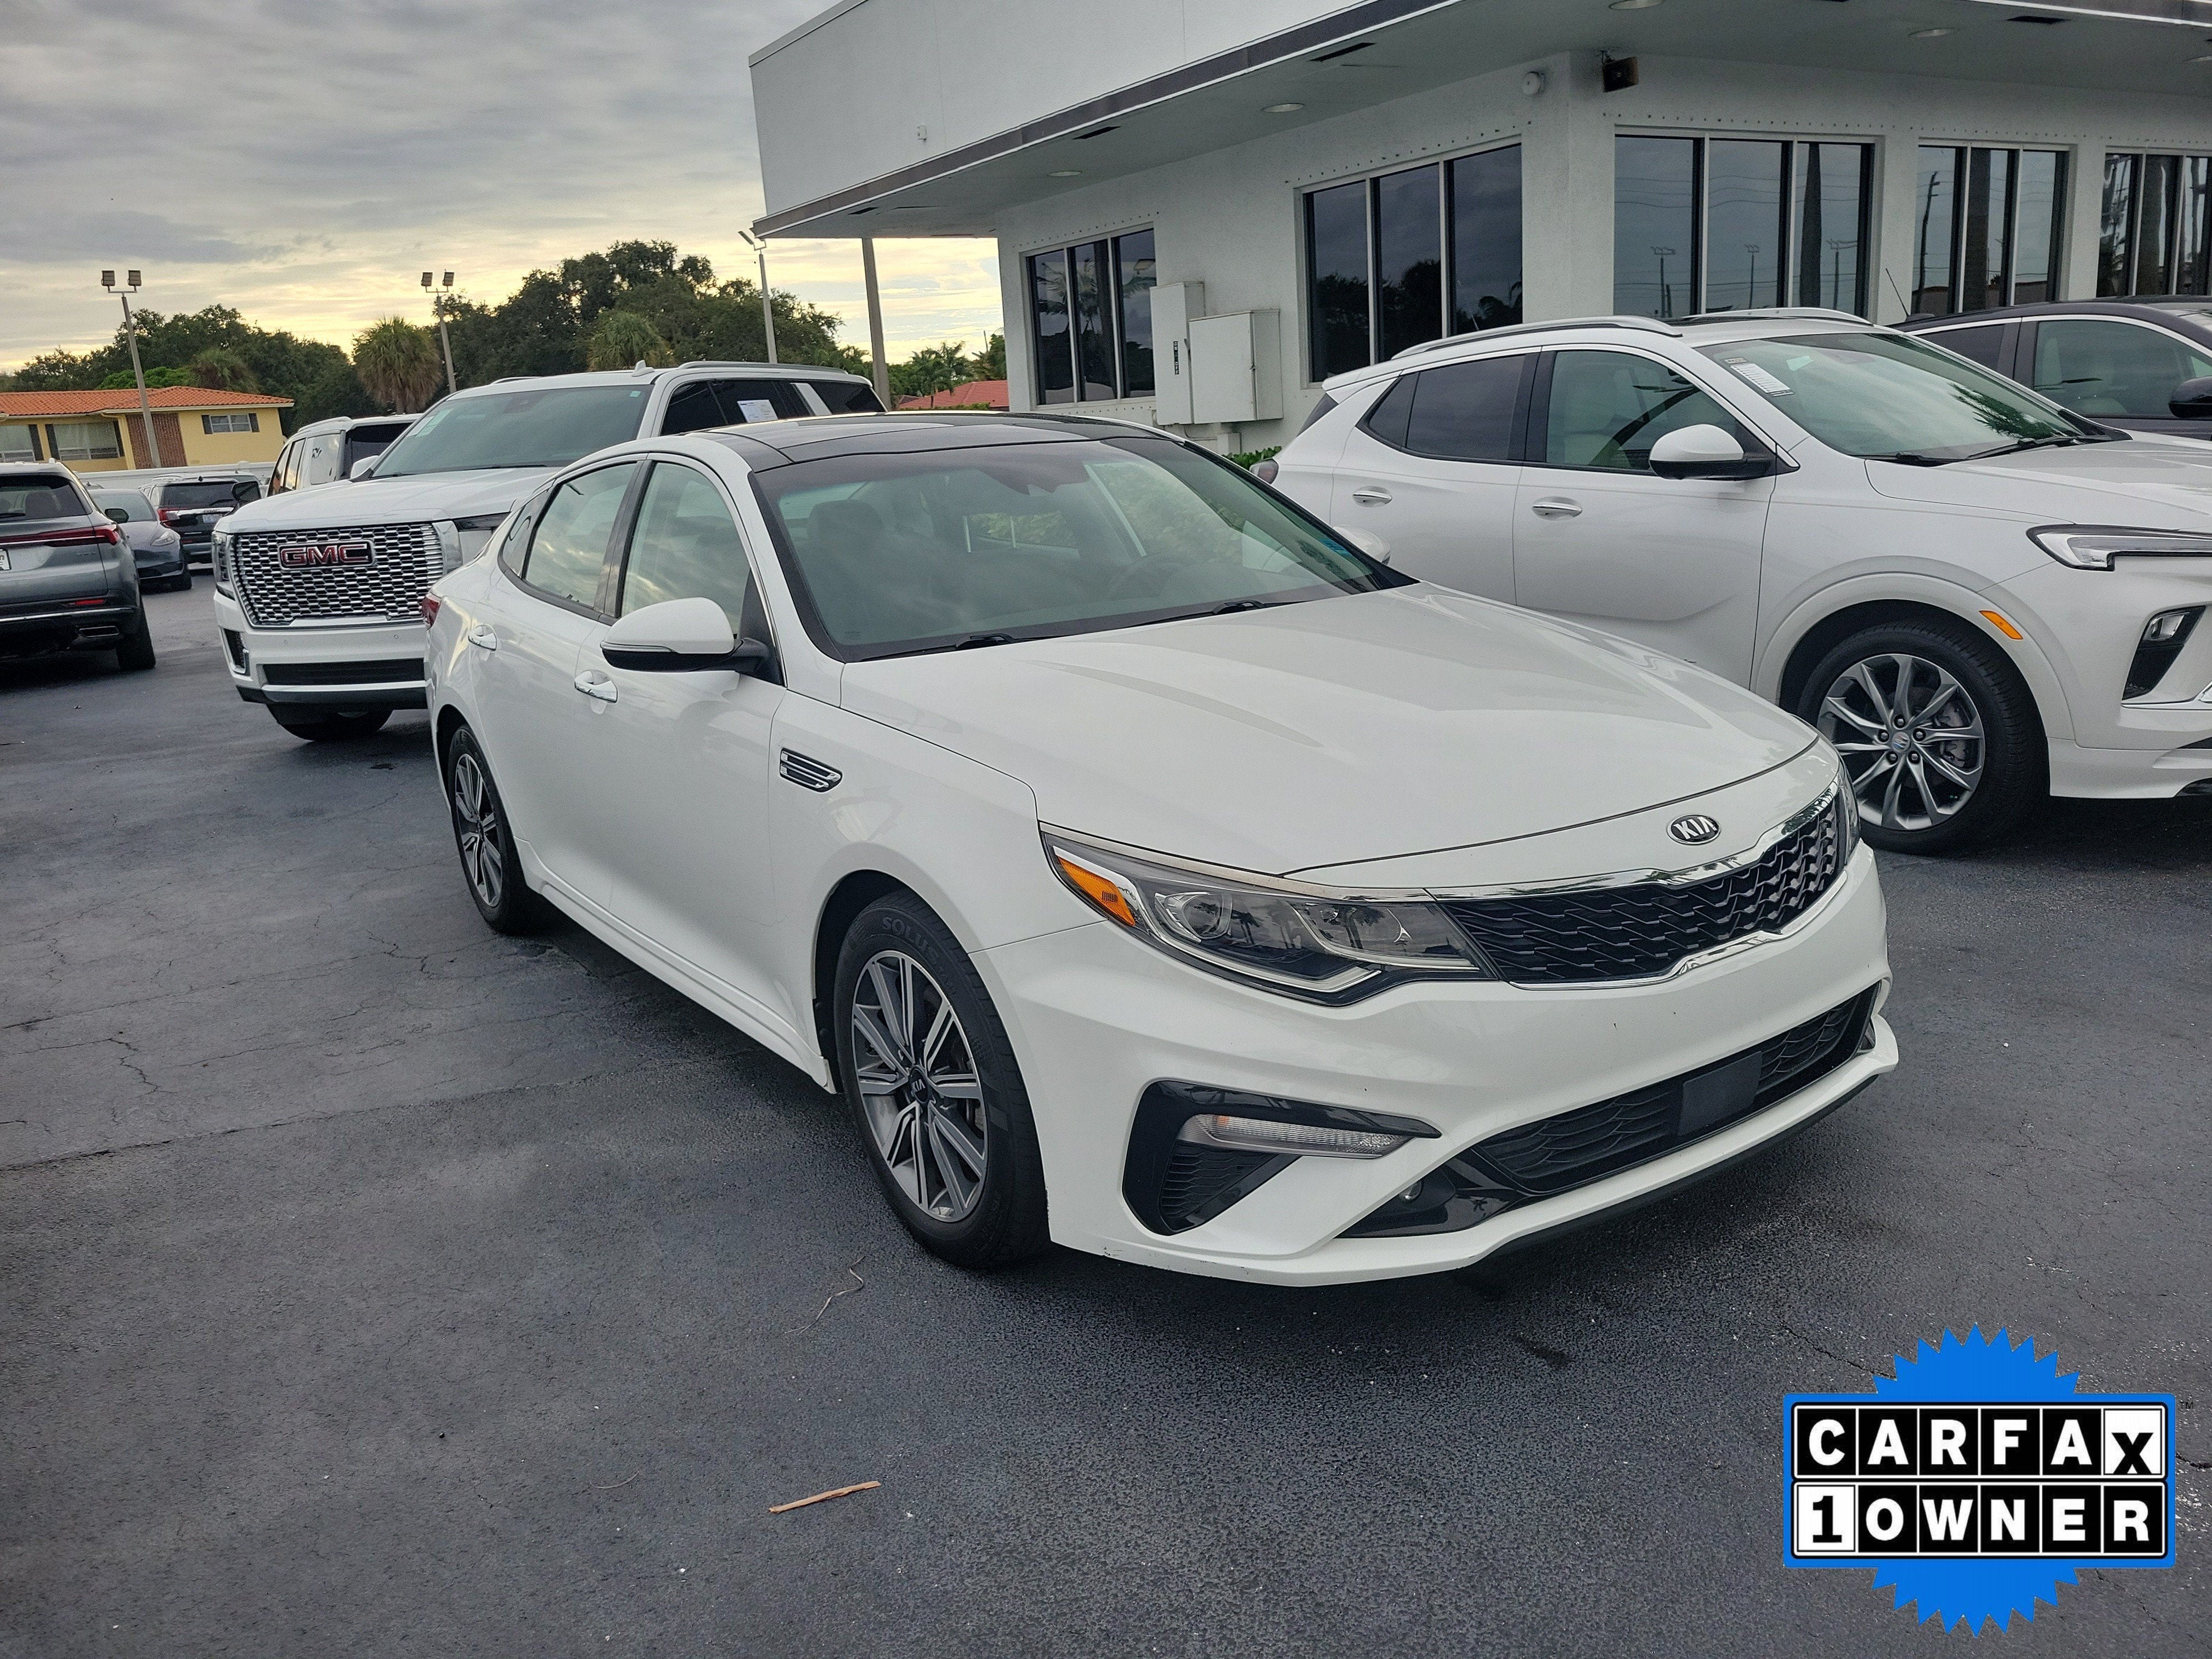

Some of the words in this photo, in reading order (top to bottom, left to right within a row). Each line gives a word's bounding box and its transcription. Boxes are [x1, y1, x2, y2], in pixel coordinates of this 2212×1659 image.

[280, 543, 369, 567] GMC
[1673, 816, 1718, 839] KIA
[911, 1079, 926, 1097] KIA
